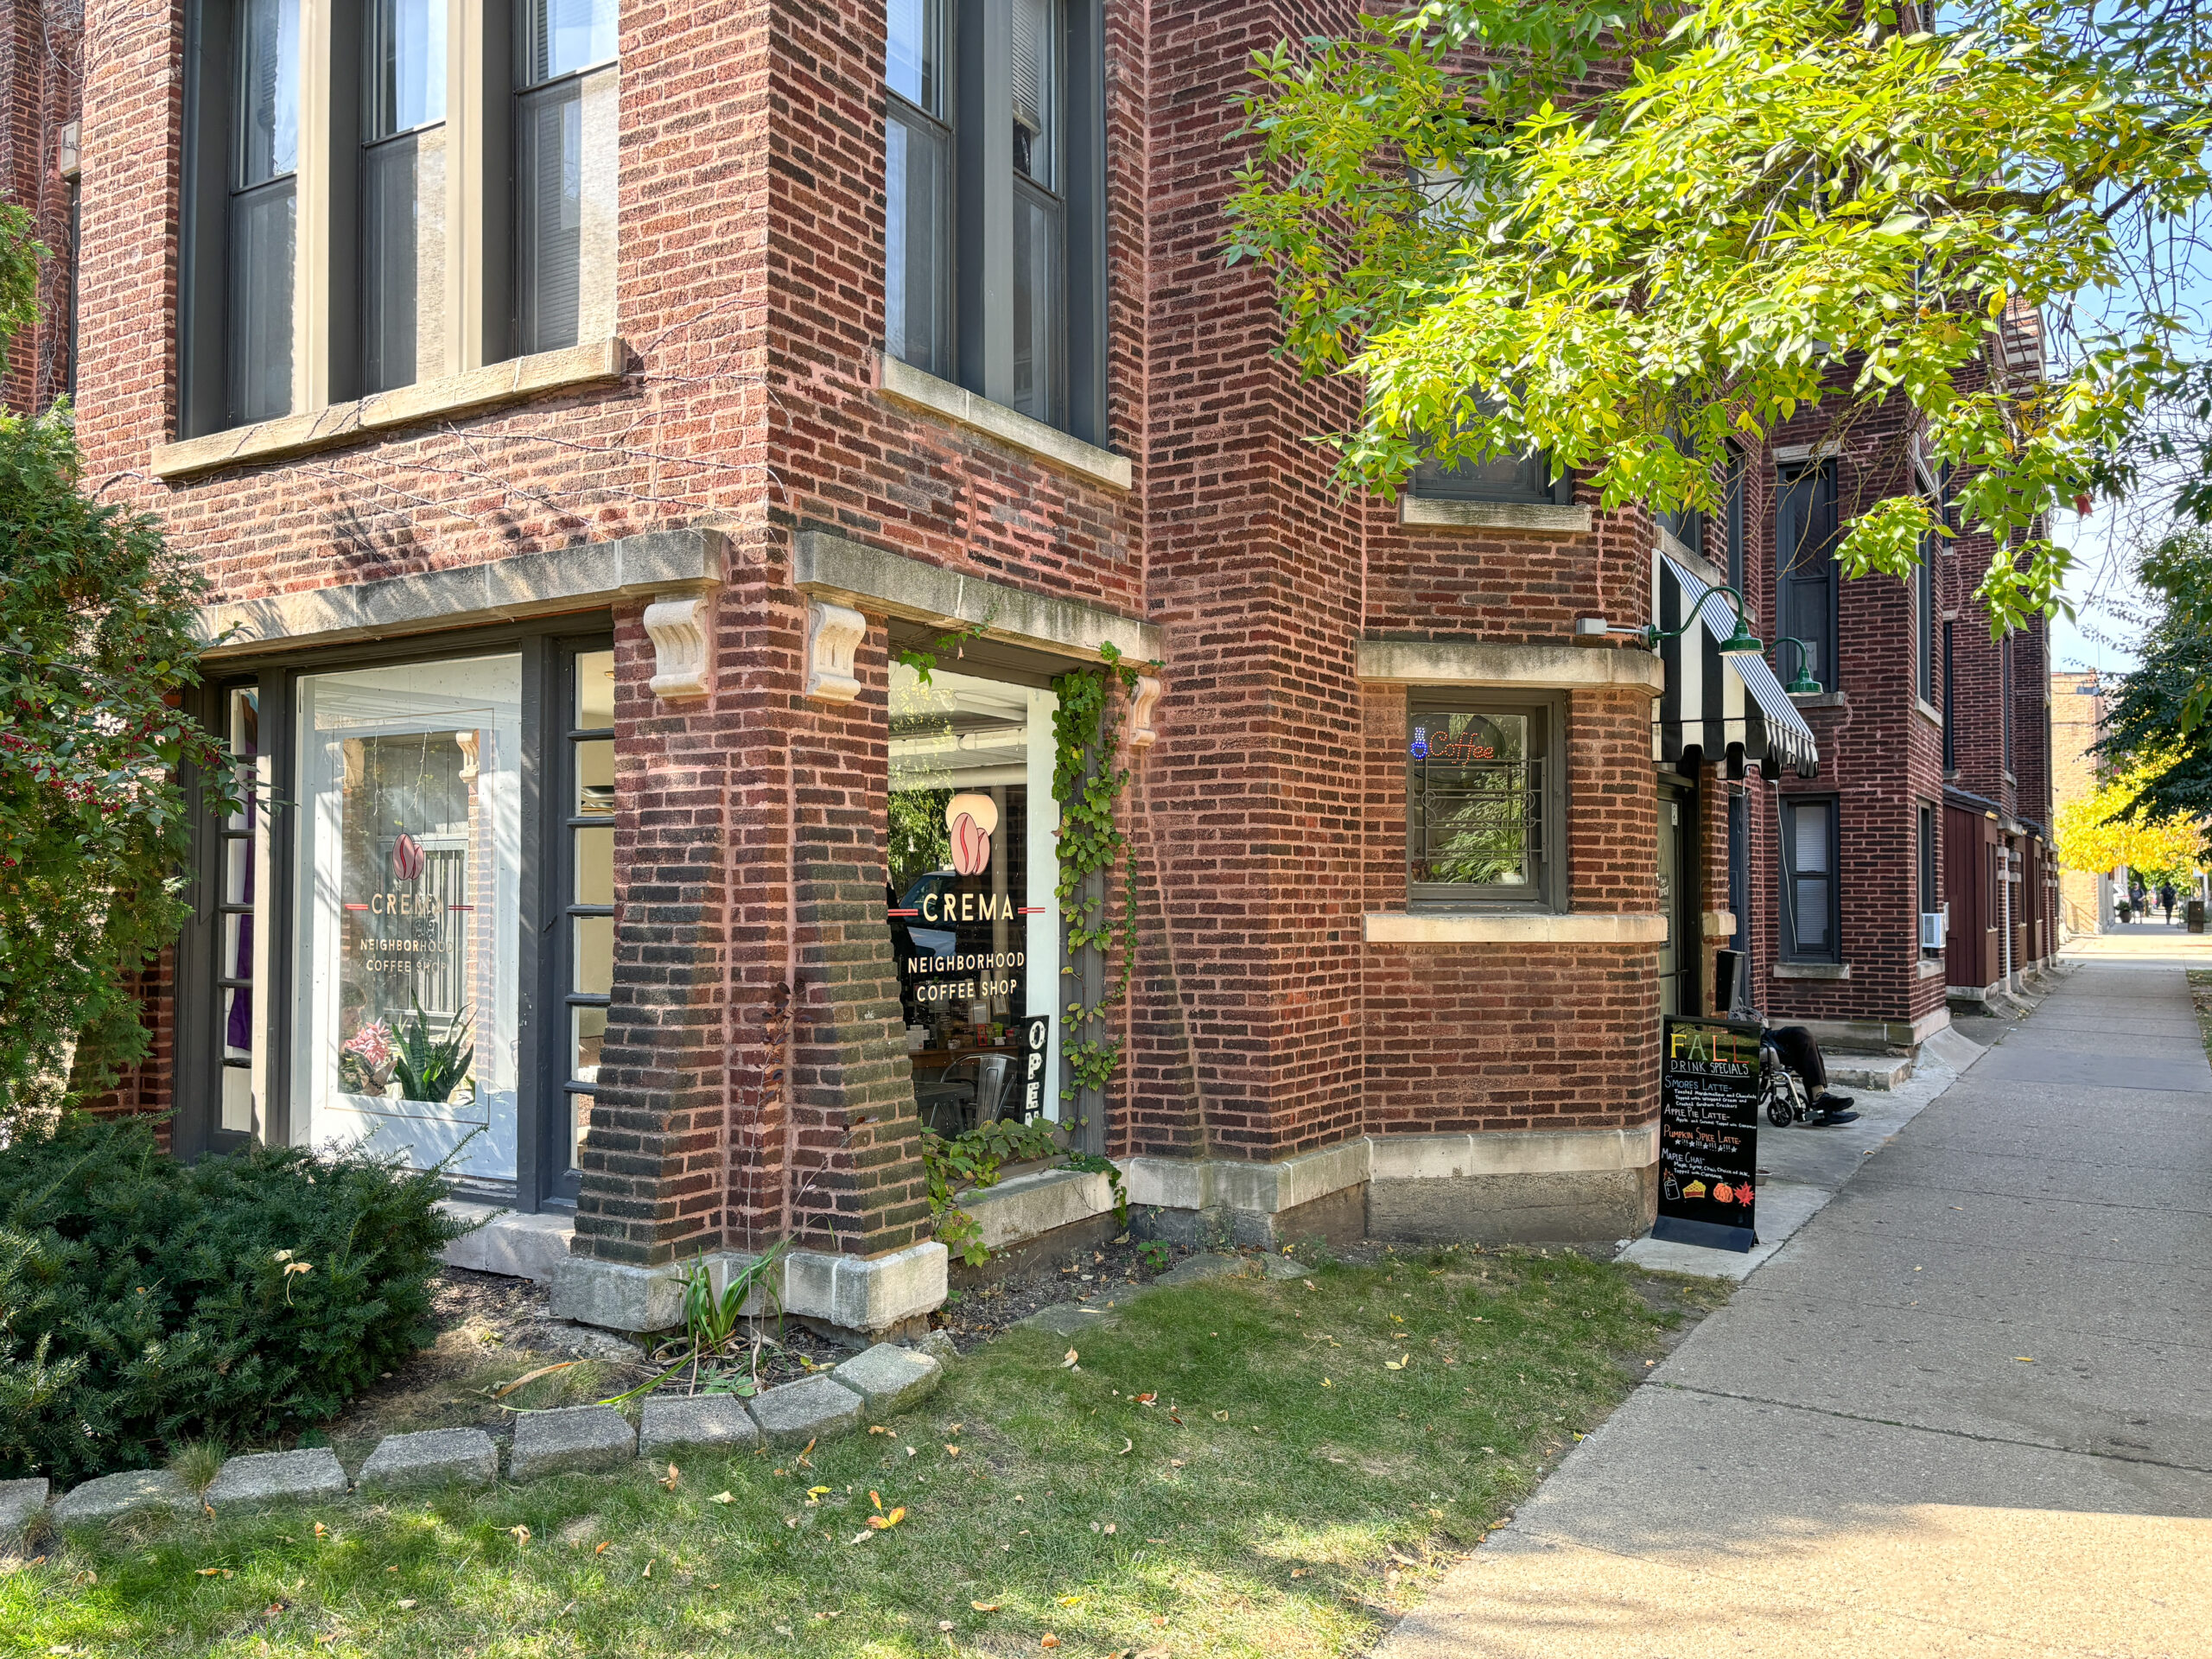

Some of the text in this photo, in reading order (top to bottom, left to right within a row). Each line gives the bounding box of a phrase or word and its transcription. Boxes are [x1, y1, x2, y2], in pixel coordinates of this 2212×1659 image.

[1427, 730, 1494, 766] Coffee
[372, 893, 443, 916] CREMA
[923, 893, 1014, 922] CREMA
[360, 938, 454, 953] NEIGHBORHOOD
[366, 959, 447, 974] COFFEE SHOP
[908, 952, 1025, 974] NEIGHBORHOOD
[917, 979, 1017, 1002] COFFEE SHOP
[1670, 1033, 1750, 1064] FALL
[1670, 1059, 1749, 1075] DRINK SPECIALS
[1664, 1075, 1699, 1090] S'MORES
[1664, 1103, 1687, 1117] APPLE
[1687, 1106, 1700, 1118] PIE
[1663, 1123, 1694, 1140] PUMPKIN
[1695, 1127, 1716, 1142] SPICE
[1661, 1147, 1684, 1162] MAPLE
